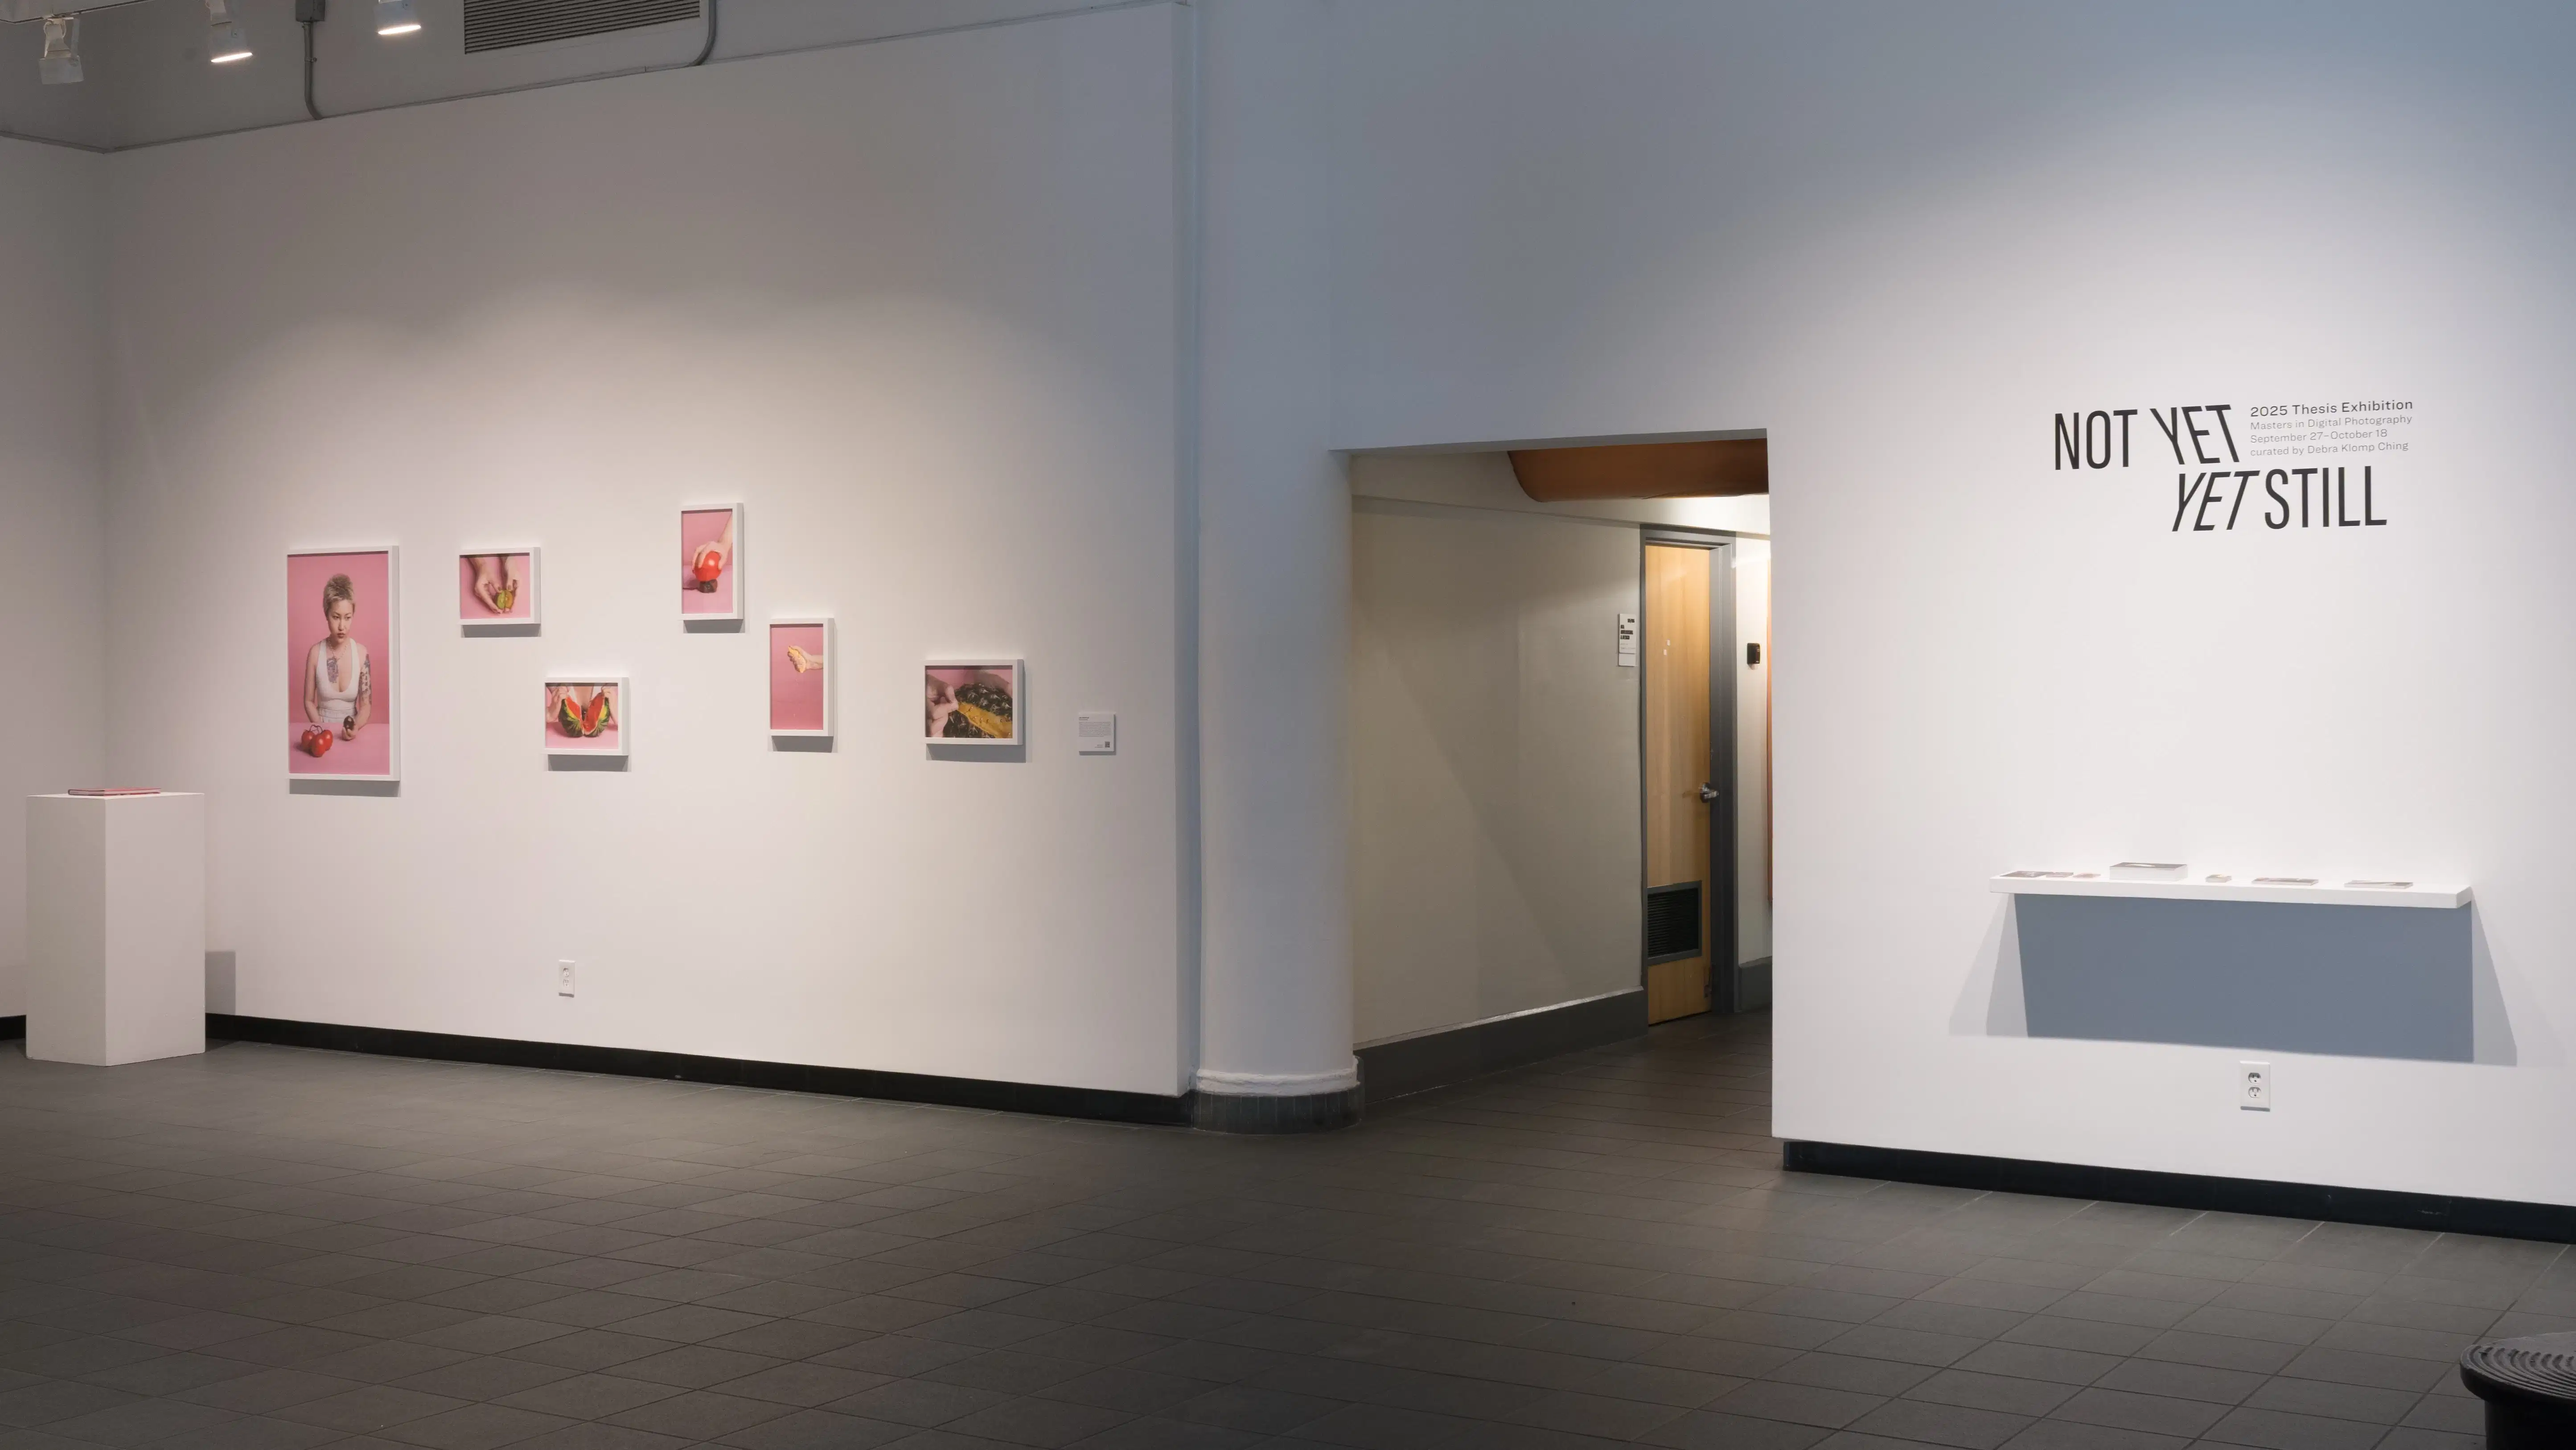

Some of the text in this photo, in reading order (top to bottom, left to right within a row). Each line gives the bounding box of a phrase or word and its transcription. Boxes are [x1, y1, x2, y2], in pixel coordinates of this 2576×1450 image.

[2250, 400, 2413, 417] 2025 Thesis Exhibition
[2250, 422, 2292, 430] Masters
[2308, 417, 2341, 428] Digital
[2345, 415, 2412, 426] Photography
[2054, 404, 2240, 470] NOT YET
[2250, 433, 2307, 444] September
[2375, 428, 2387, 437] 18
[2250, 442, 2409, 456] curated by Debra Klomp Ching
[2171, 465, 2388, 532] YET STILL
